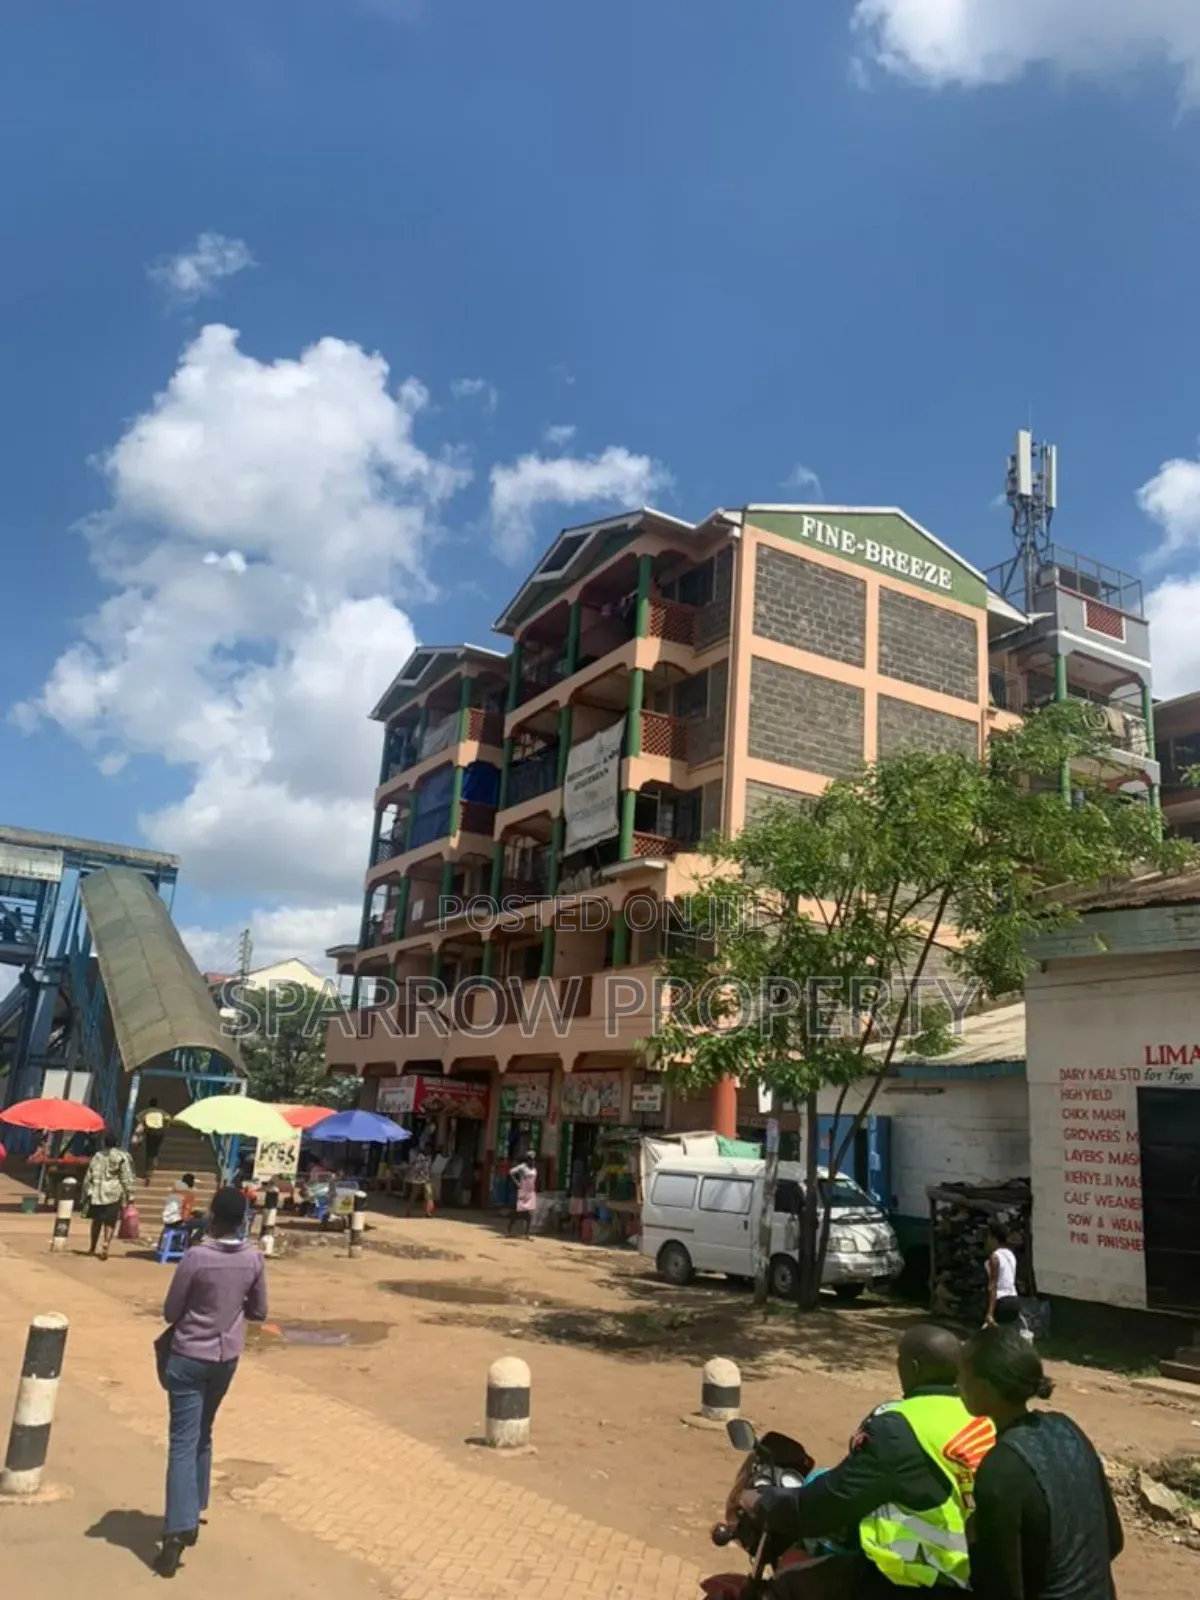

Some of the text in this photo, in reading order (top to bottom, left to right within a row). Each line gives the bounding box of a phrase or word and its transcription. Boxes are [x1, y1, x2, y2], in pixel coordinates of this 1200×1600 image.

[800, 515, 953, 590] FINE-BREEZE
[1088, 1068, 1117, 1080] MEAL
[1119, 1068, 1141, 1080] STD
[1092, 1109, 1126, 1121] MASH
[1063, 1127, 1121, 1142] GROWERS
[1065, 1149, 1104, 1163] LAYERS
[1063, 1191, 1091, 1205] CALF
[1067, 1213, 1092, 1226] SOW
[1070, 1231, 1088, 1244] PIG
